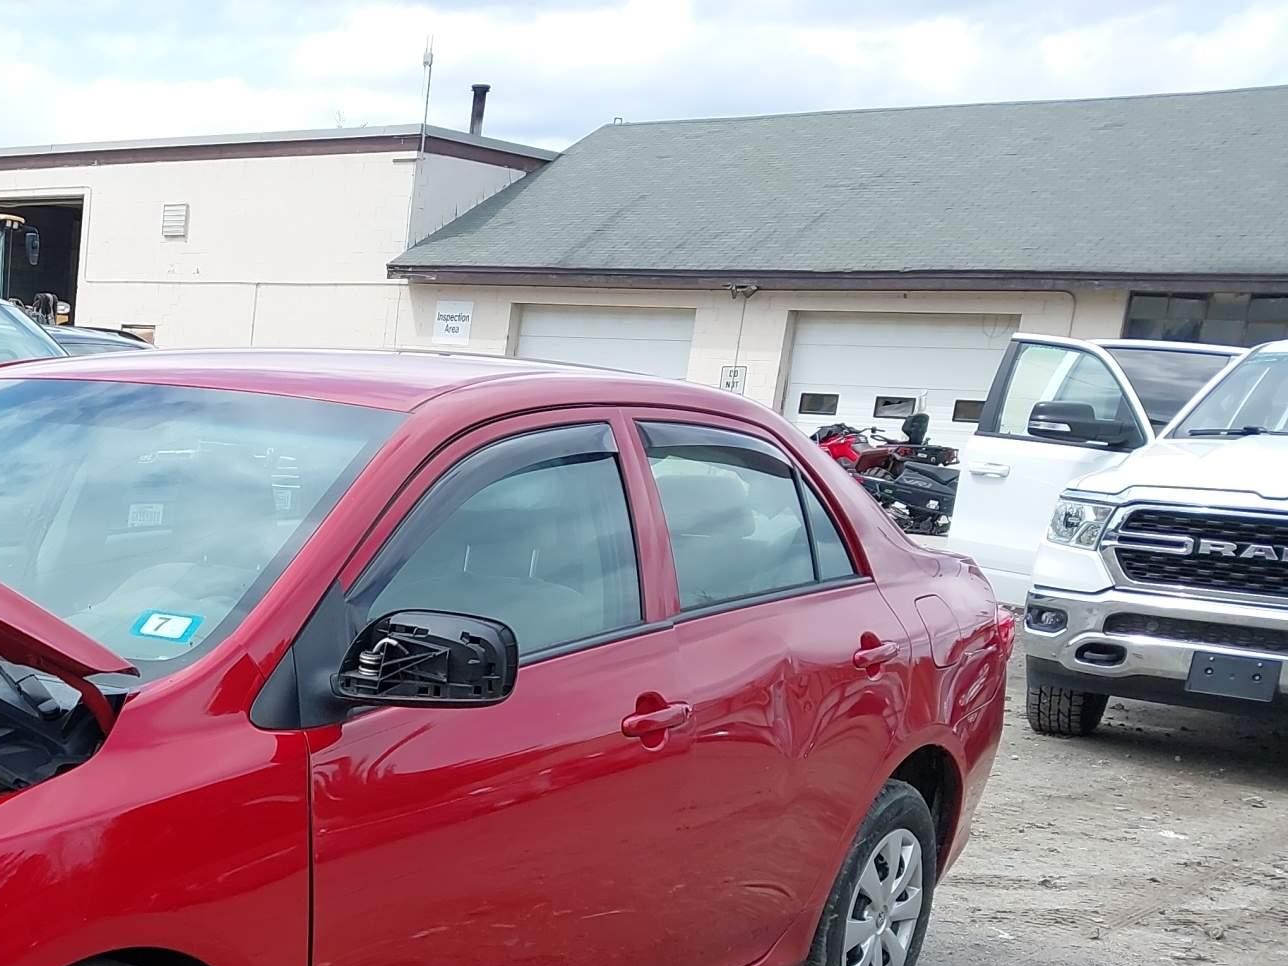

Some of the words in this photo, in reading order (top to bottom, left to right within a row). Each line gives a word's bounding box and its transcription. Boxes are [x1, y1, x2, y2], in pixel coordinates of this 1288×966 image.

[437, 311, 470, 323] Inspection
[444, 323, 460, 334] Area
[1198, 538, 1288, 562] RA
[153, 616, 173, 632] 7
